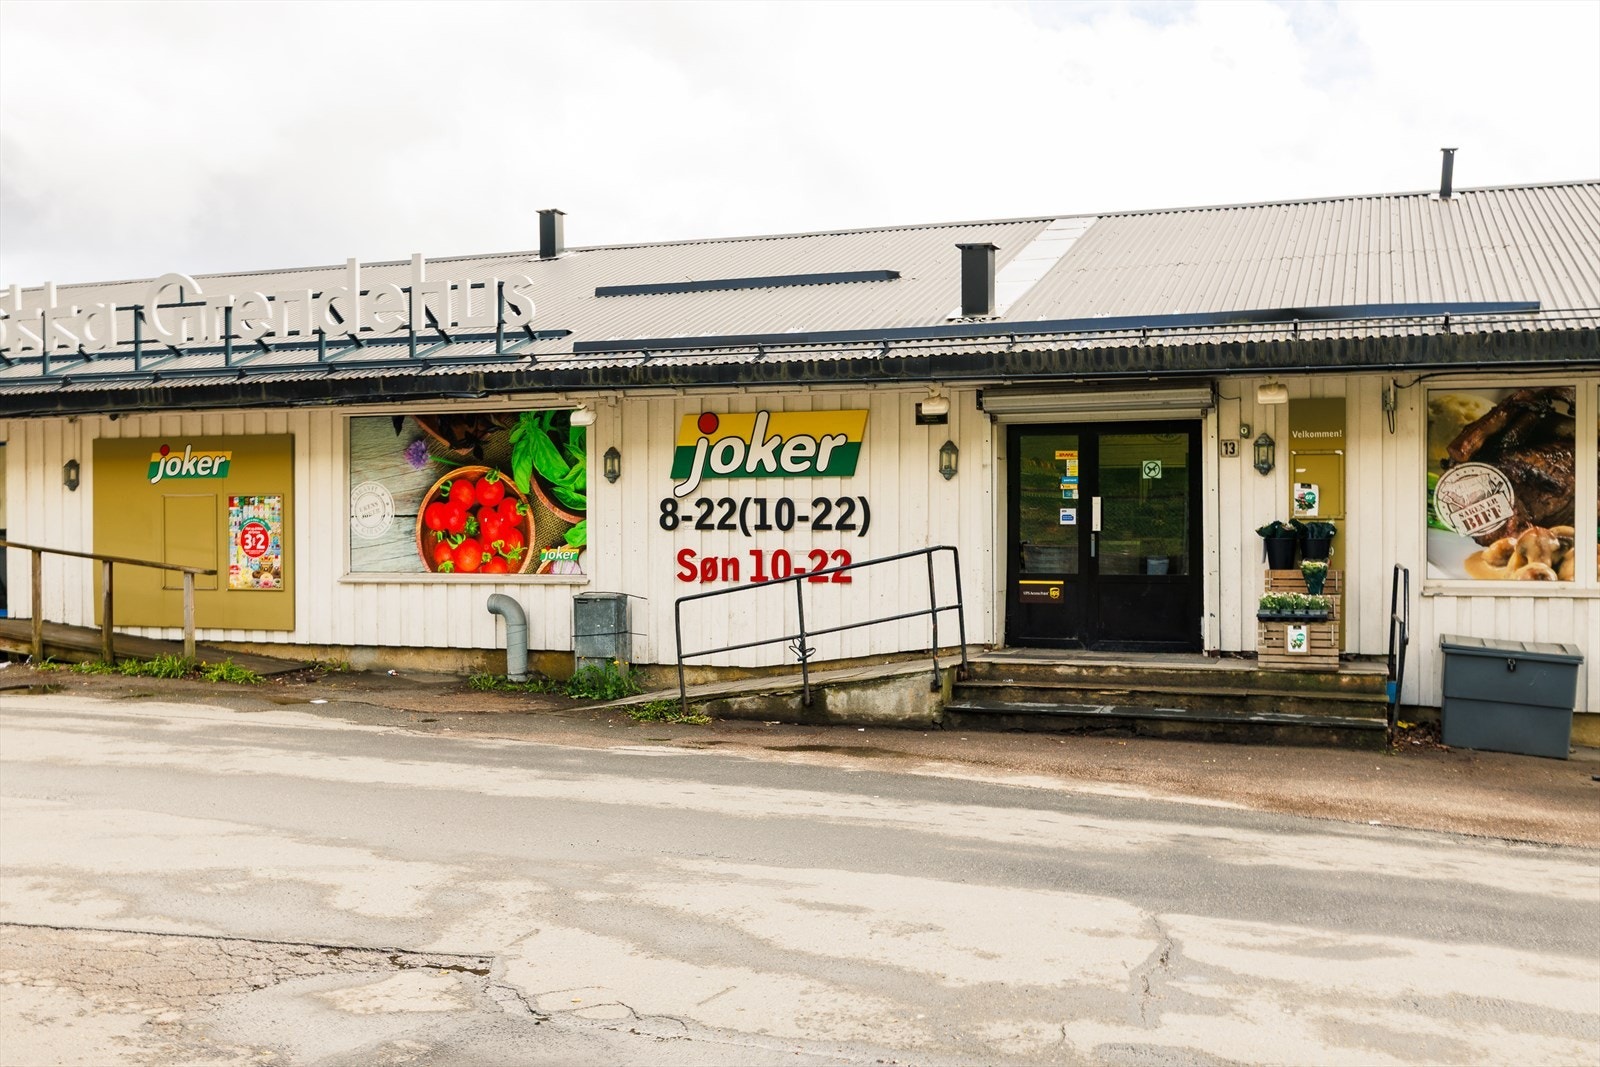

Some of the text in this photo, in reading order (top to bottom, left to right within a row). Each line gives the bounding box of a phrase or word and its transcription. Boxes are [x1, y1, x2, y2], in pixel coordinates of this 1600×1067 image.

[0, 253, 536, 353] kka Grendehus
[1223, 442, 1236, 455] 13
[1292, 429, 1342, 438] Velkommen!
[150, 444, 226, 484] joker
[673, 410, 847, 497] joker
[659, 496, 871, 537] 8-22(10-22)
[1462, 504, 1502, 531] BIFF
[244, 533, 252, 549] 3
[256, 533, 265, 549] 2
[541, 545, 576, 562] joker
[676, 549, 852, 584] Søn 10-22
